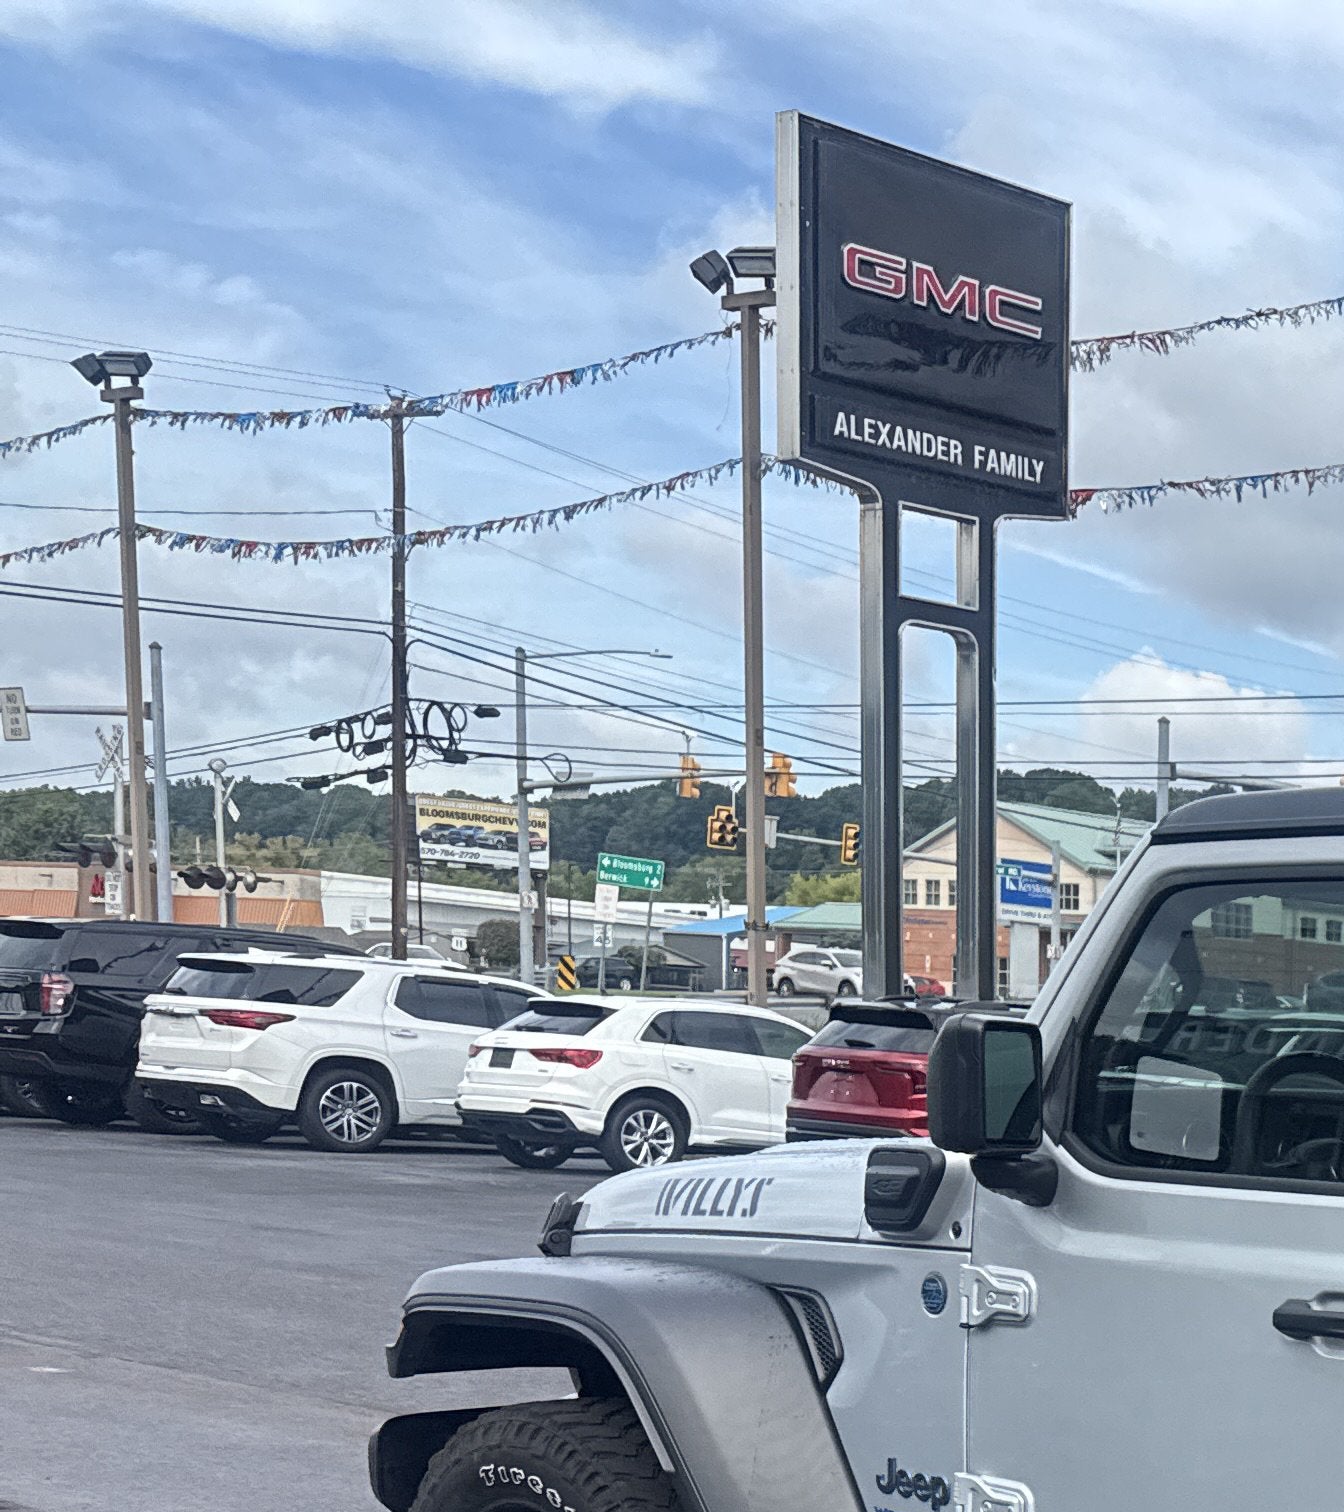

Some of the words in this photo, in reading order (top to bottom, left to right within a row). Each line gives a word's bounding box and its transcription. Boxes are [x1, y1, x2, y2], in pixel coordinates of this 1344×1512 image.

[842, 242, 1042, 339] GMC
[834, 411, 963, 466] ALEXANDER
[973, 445, 1044, 483] FAMILY
[419, 807, 547, 829] BLOOMSBURGCHEVYCOM
[600, 870, 627, 882] Berwick
[612, 858, 653, 874] Bloomsburg
[656, 864, 662, 874] 2
[655, 1177, 774, 1218] WILLYS
[876, 1457, 951, 1512] Jeep
